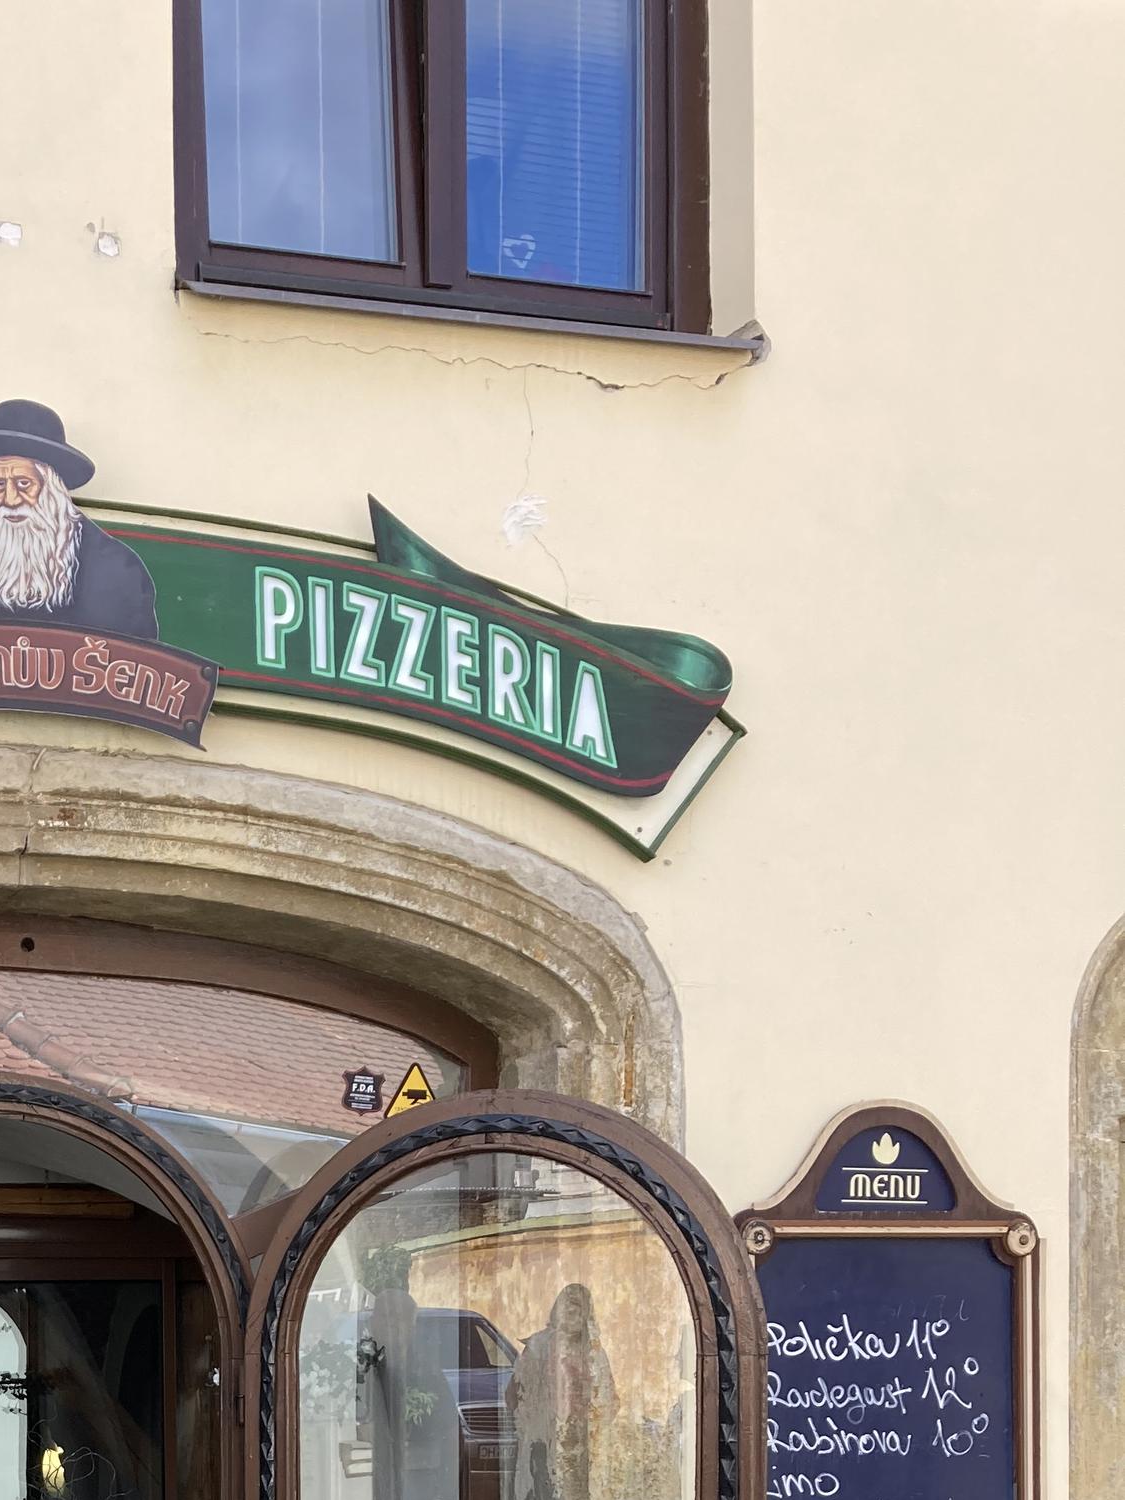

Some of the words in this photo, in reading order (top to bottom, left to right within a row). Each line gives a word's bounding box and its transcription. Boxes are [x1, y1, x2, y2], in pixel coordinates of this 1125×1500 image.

[72, 636, 191, 719] ŠENK
[254, 565, 618, 768] PIZZERIA
[849, 1173, 921, 1199] MENU
[766, 1314, 901, 1361] Polička
[766, 1371, 912, 1425] Radegast
[766, 1465, 840, 1498] imo
